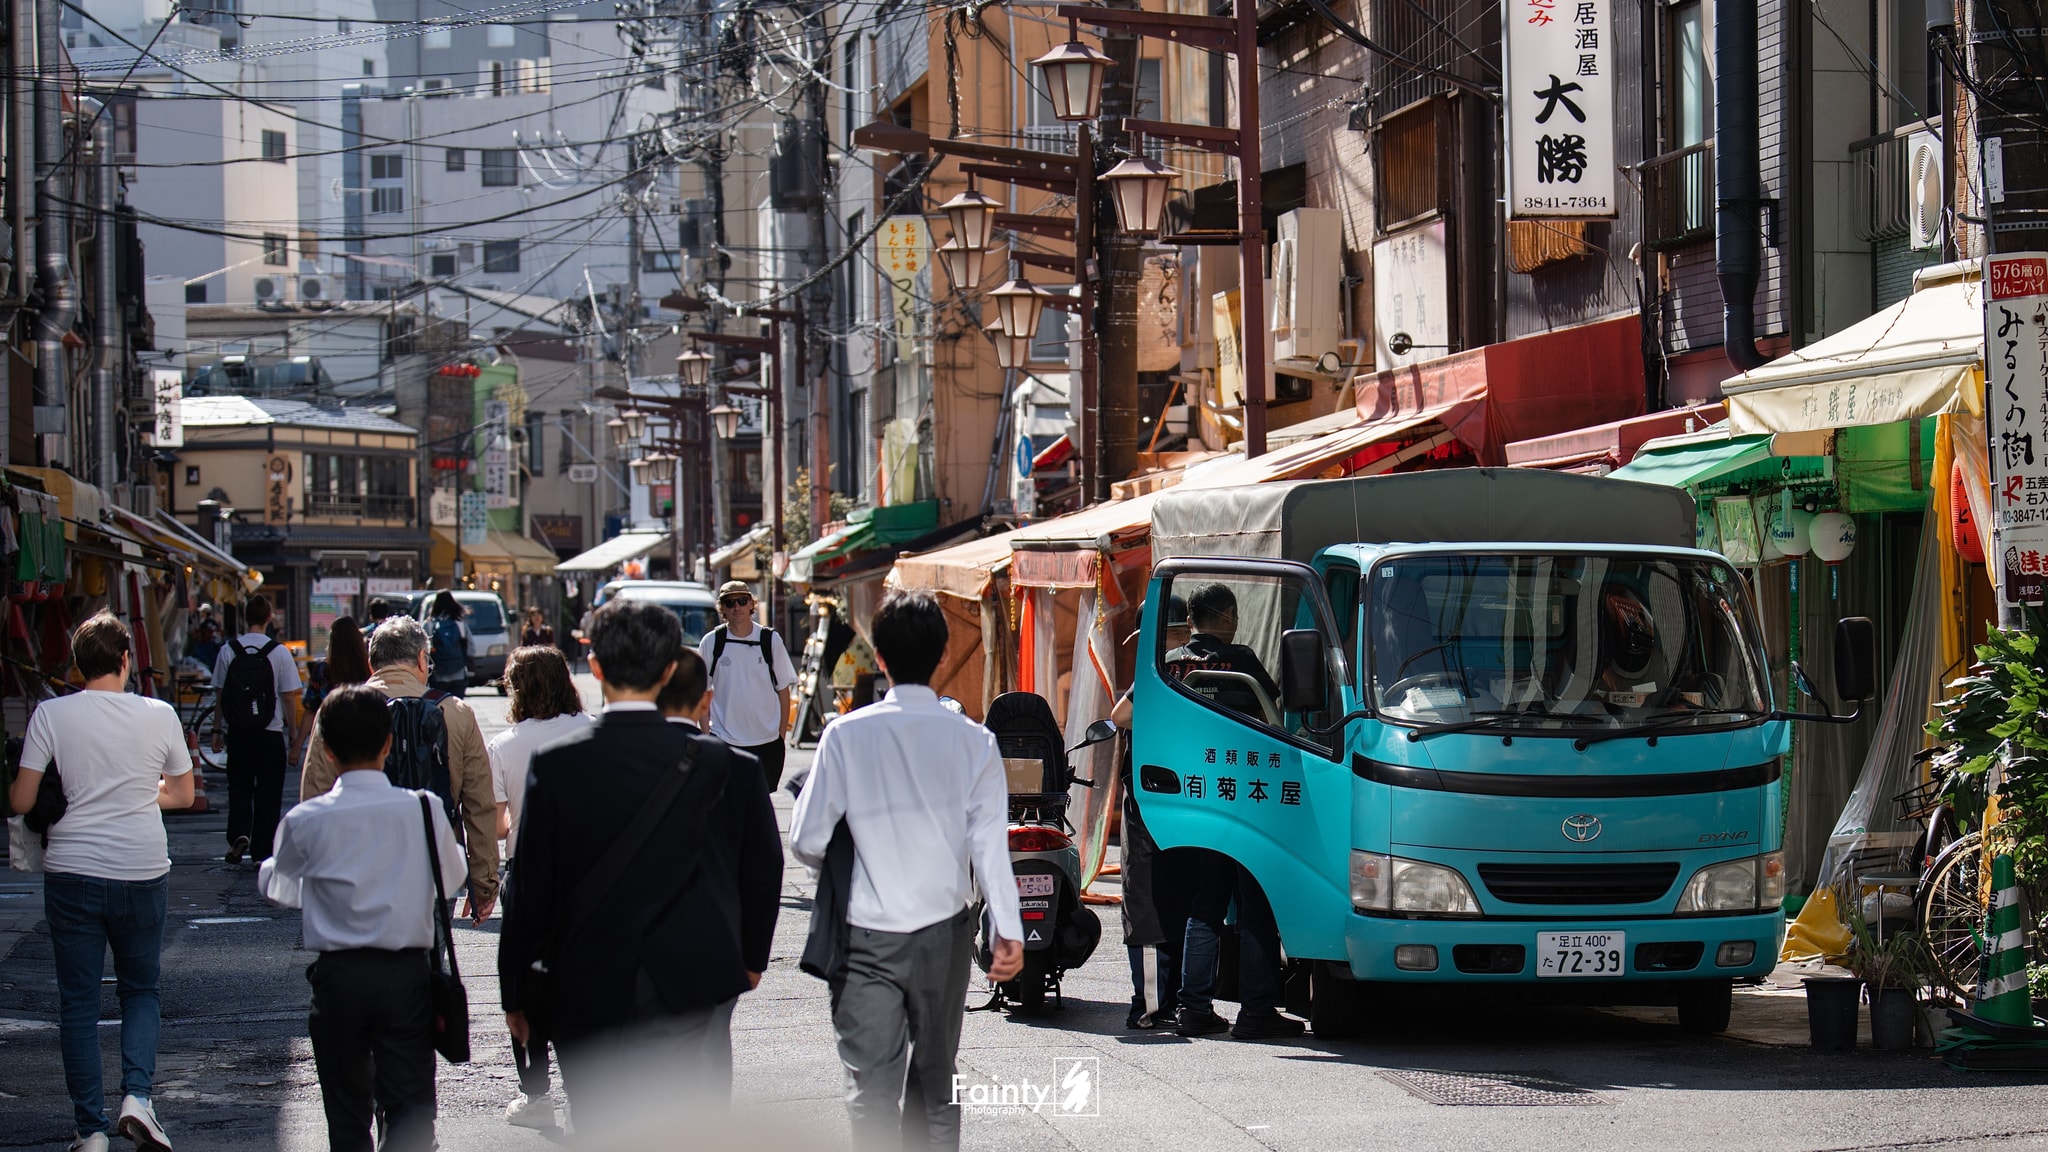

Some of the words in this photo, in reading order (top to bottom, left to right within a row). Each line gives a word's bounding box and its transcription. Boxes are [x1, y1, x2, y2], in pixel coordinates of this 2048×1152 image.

[1574, 2, 1599, 76] 居酒屋
[1533, 74, 1587, 184] 大勝
[1524, 196, 1607, 209] 3841-7364
[905, 222, 917, 272] お好み焼
[1992, 262, 2044, 280] 576層の
[1993, 279, 2045, 296] りんごパイ
[895, 278, 912, 340] つくし
[1998, 305, 2035, 470] みるくの樹
[1204, 747, 1281, 768] 酒類販売
[1698, 831, 1748, 843] DYNA
[1559, 935, 1583, 948] 足立
[1585, 935, 1607, 947] 400
[1542, 957, 1553, 968] た
[1557, 950, 1620, 973] 72-39
